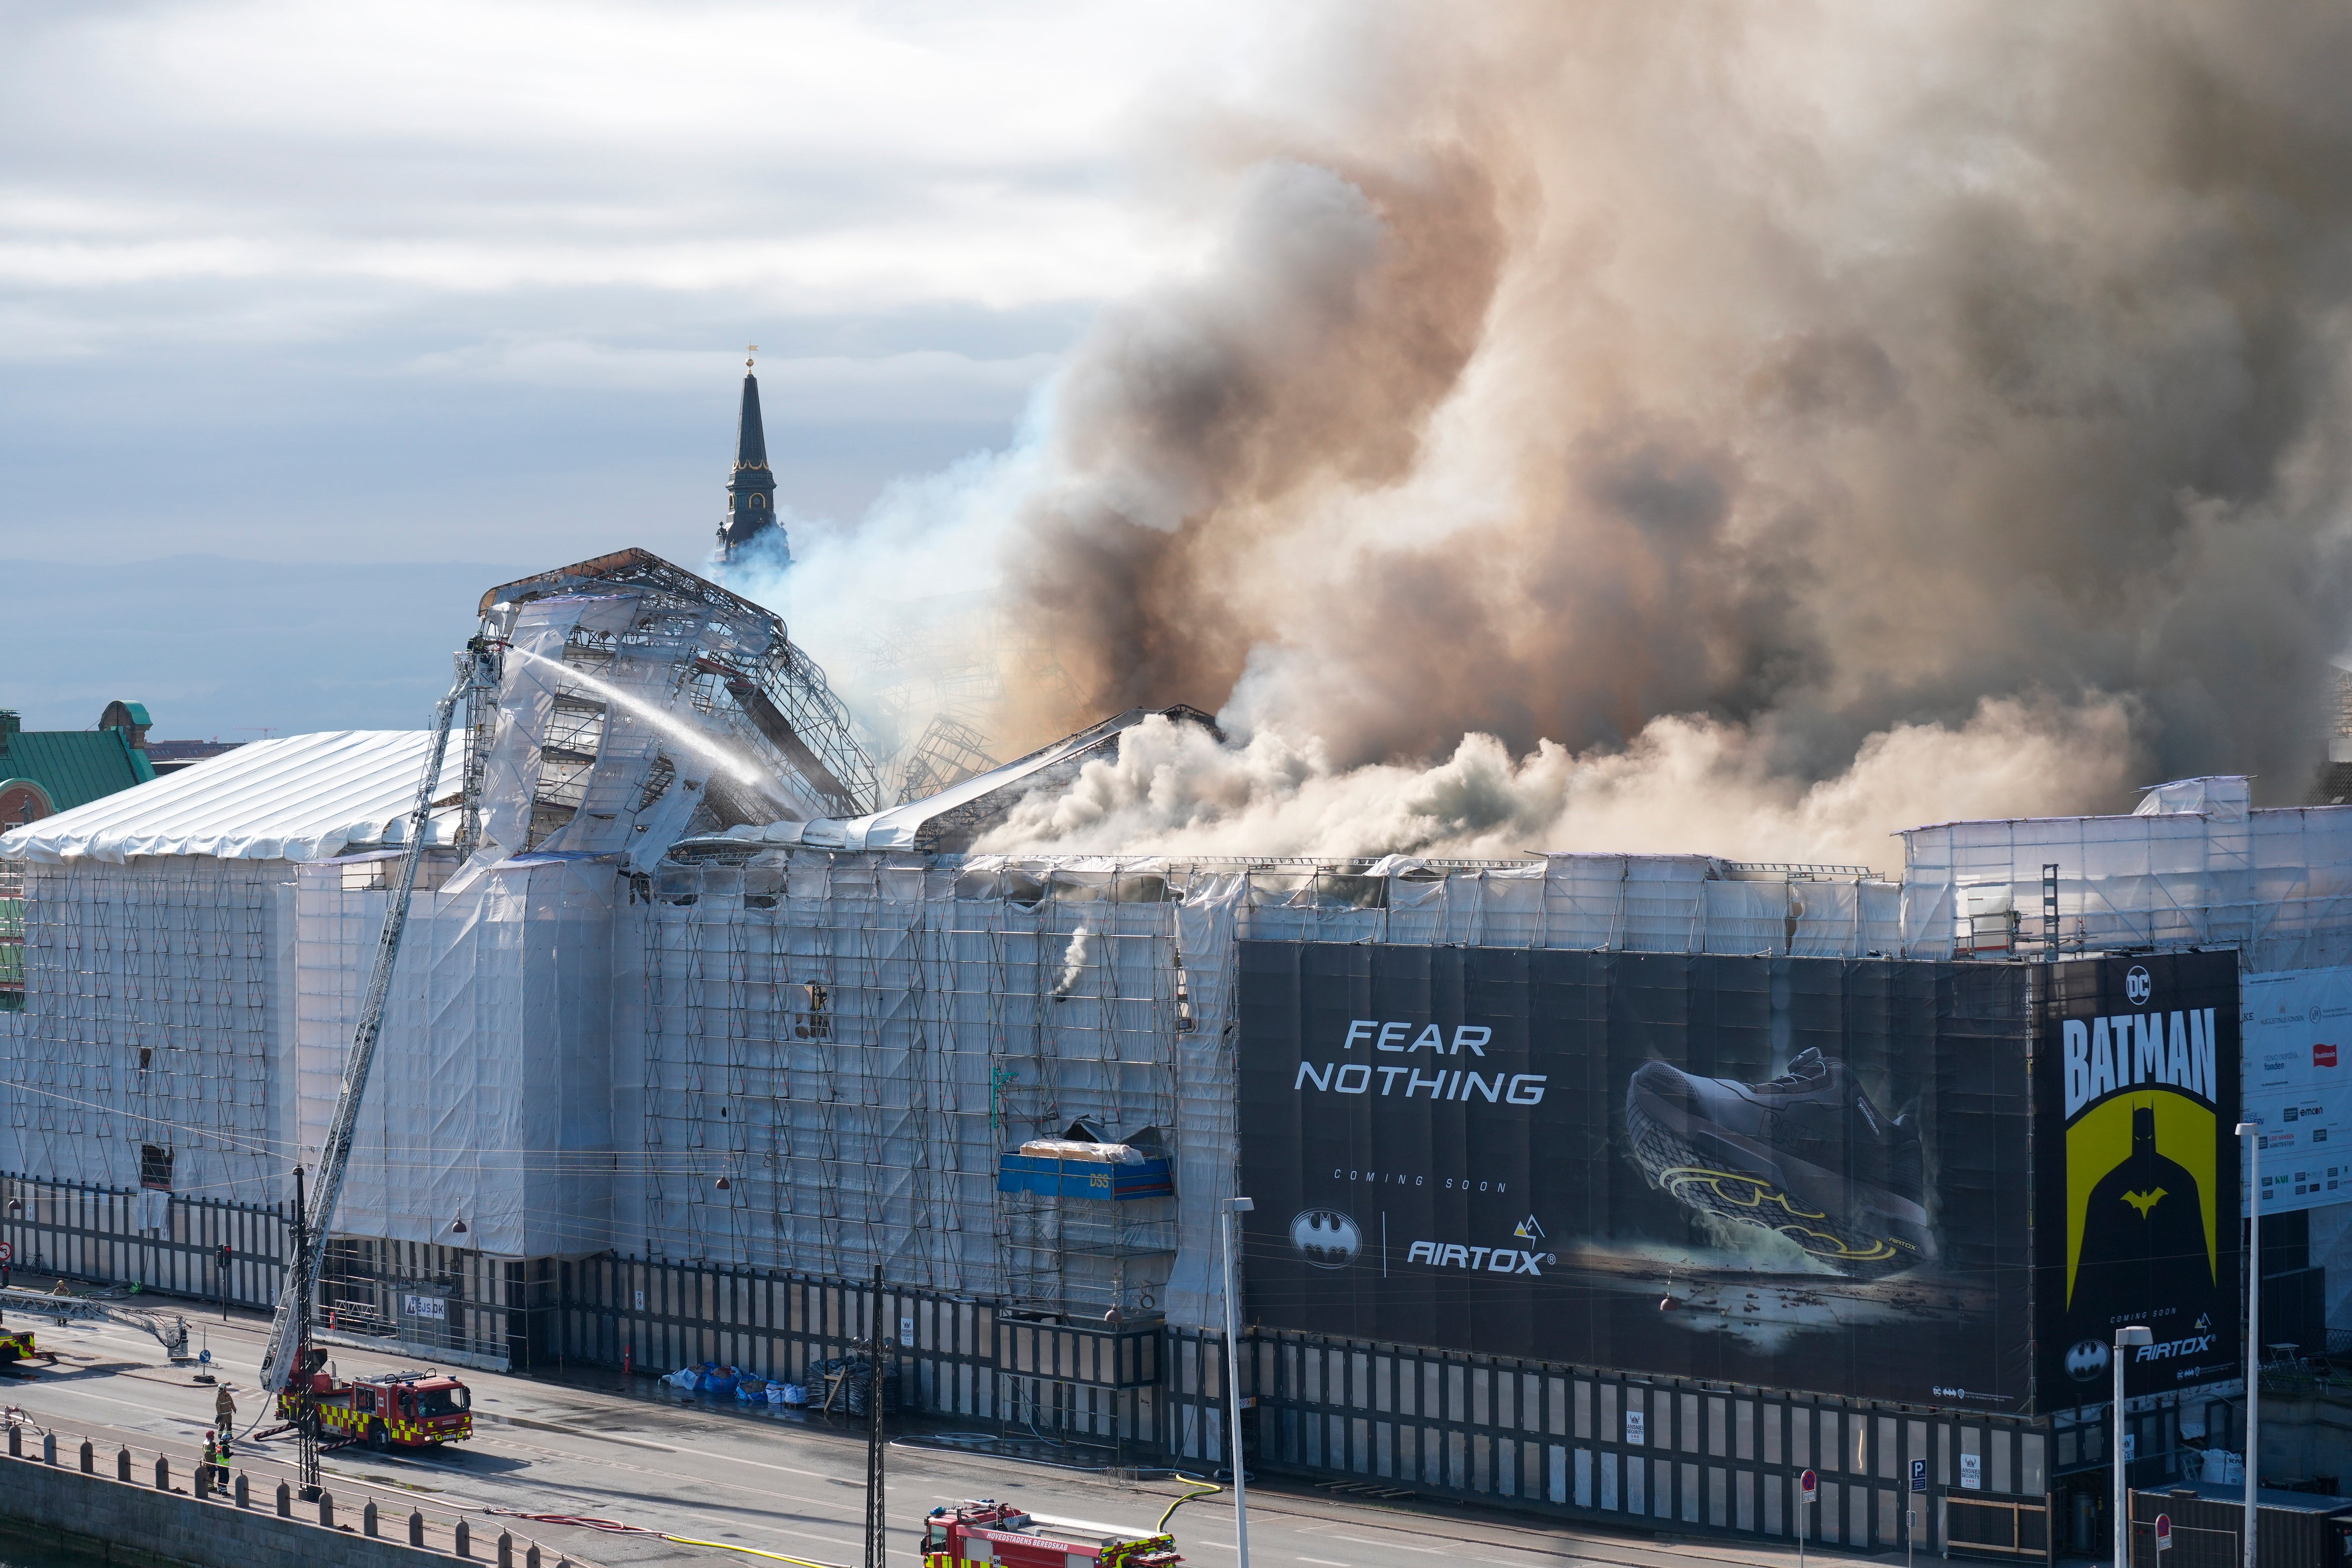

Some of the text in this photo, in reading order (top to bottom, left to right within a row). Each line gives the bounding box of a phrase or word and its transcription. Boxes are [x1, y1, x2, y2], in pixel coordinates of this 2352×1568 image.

[2243, 1012, 2254, 1021] KE
[1344, 1020, 1492, 1056] FEAR
[2063, 1008, 2216, 1120] BATMAN
[2264, 1062, 2285, 1071] fonden
[1294, 1061, 1547, 1105] NOTHING
[2300, 1106, 2323, 1116] emcon
[1090, 1173, 1109, 1188] DSS
[1334, 1169, 1507, 1193] COMING SOON
[1889, 1237, 1916, 1251] AIRTOX
[311, 1261, 321, 1287] BEREDSKAB
[406, 1297, 443, 1315] HEJS.DK
[2110, 1307, 2177, 1323] COMING SOON
[1914, 1462, 1923, 1477] P
[986, 1532, 1069, 1551] HOVEDSTADENS BEREDSKAB
